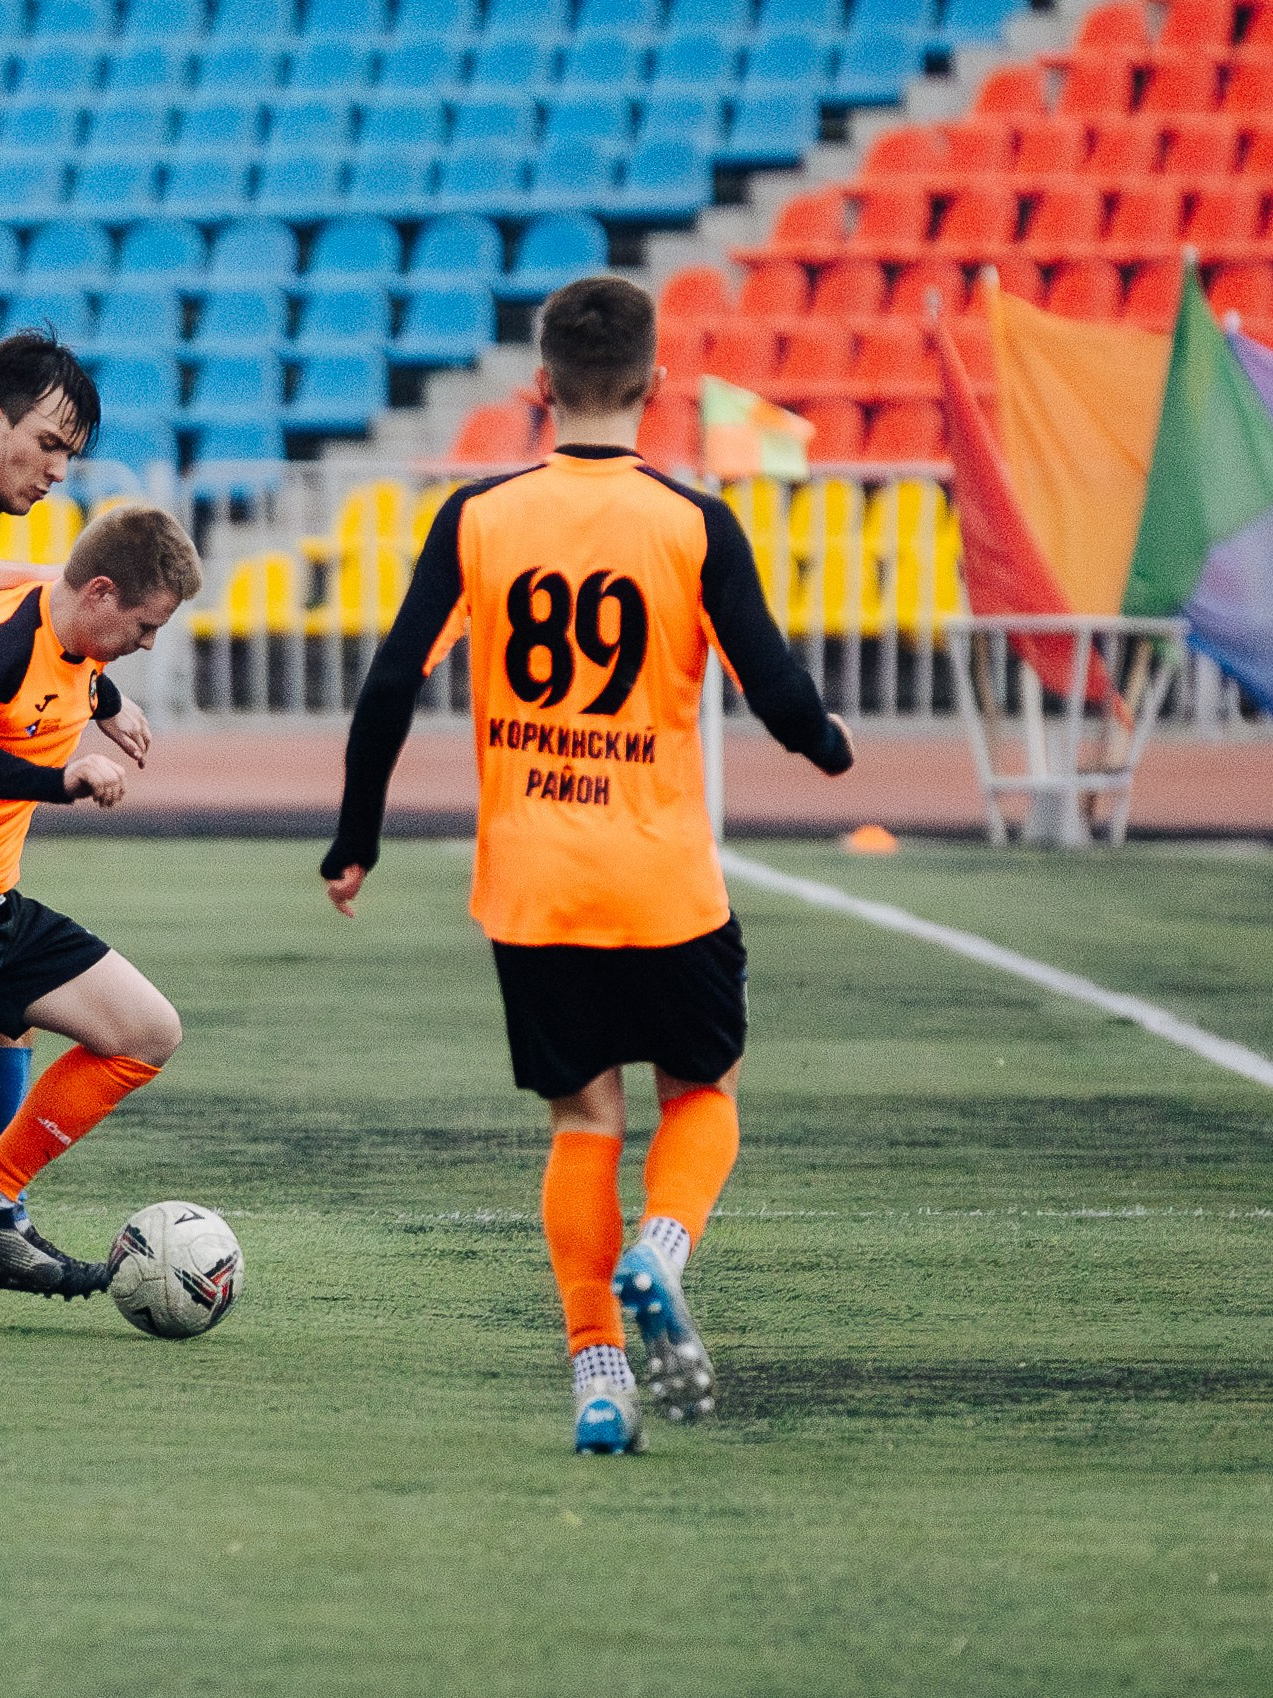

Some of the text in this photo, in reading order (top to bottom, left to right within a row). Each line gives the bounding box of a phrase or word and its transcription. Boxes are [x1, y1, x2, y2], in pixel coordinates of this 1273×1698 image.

[505, 566, 648, 716] 89
[489, 717, 657, 764] КОРКИНСКИЙ
[525, 765, 611, 806] РАЙОН
